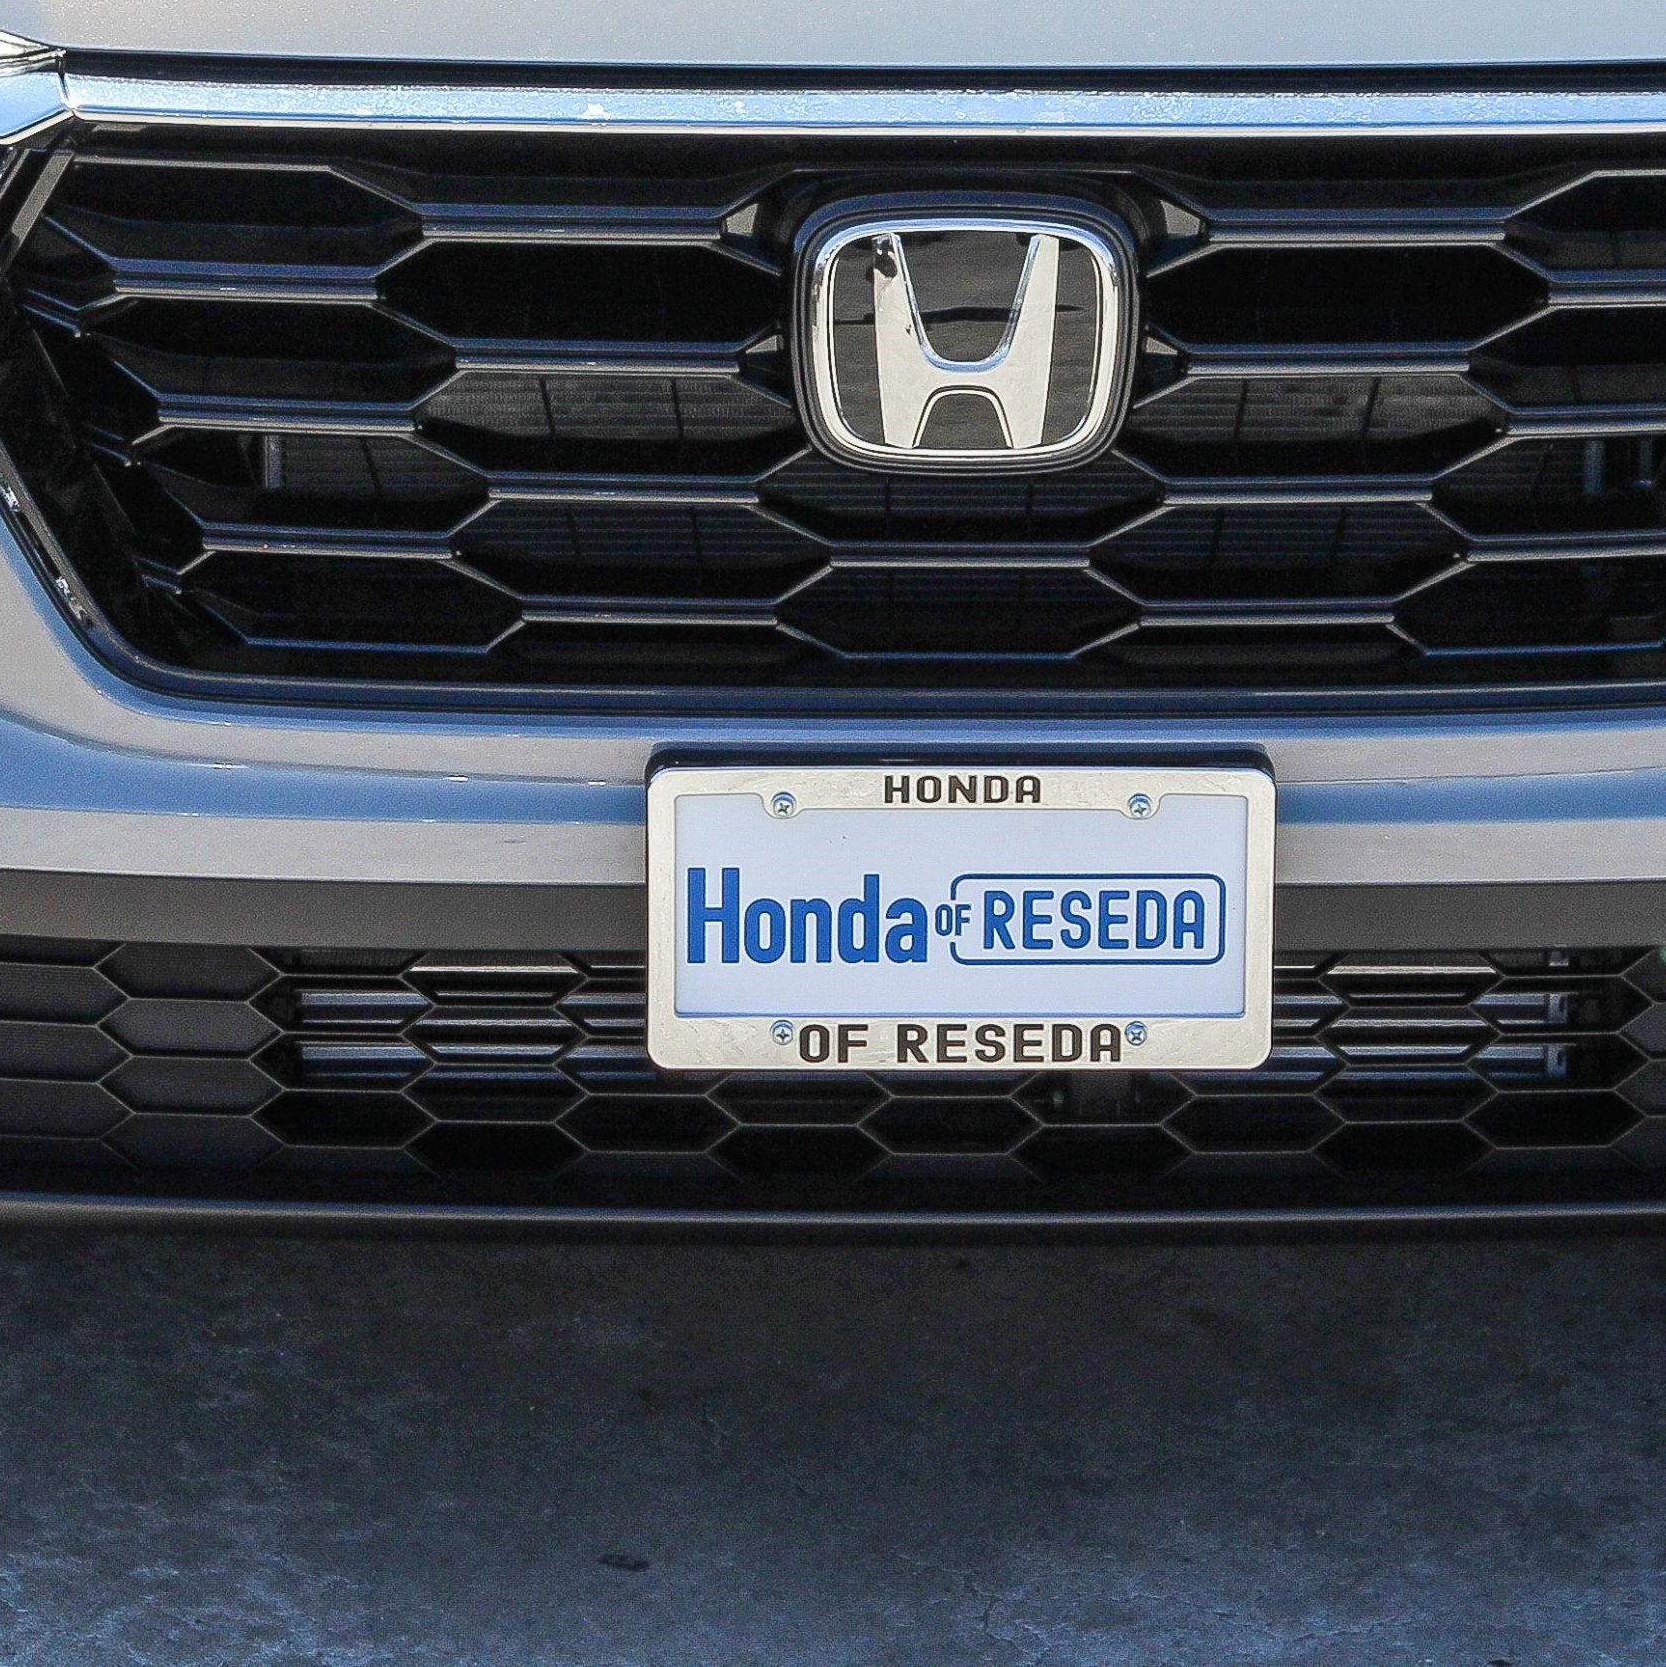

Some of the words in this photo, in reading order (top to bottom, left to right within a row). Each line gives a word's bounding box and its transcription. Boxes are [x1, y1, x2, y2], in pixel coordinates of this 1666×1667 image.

[884, 775, 1042, 804] HONDA
[686, 867, 929, 964] Honda
[934, 902, 972, 937] OF
[982, 890, 1205, 950] RESEDA
[798, 1023, 869, 1064] OF
[896, 1023, 1123, 1064] RESEDA
